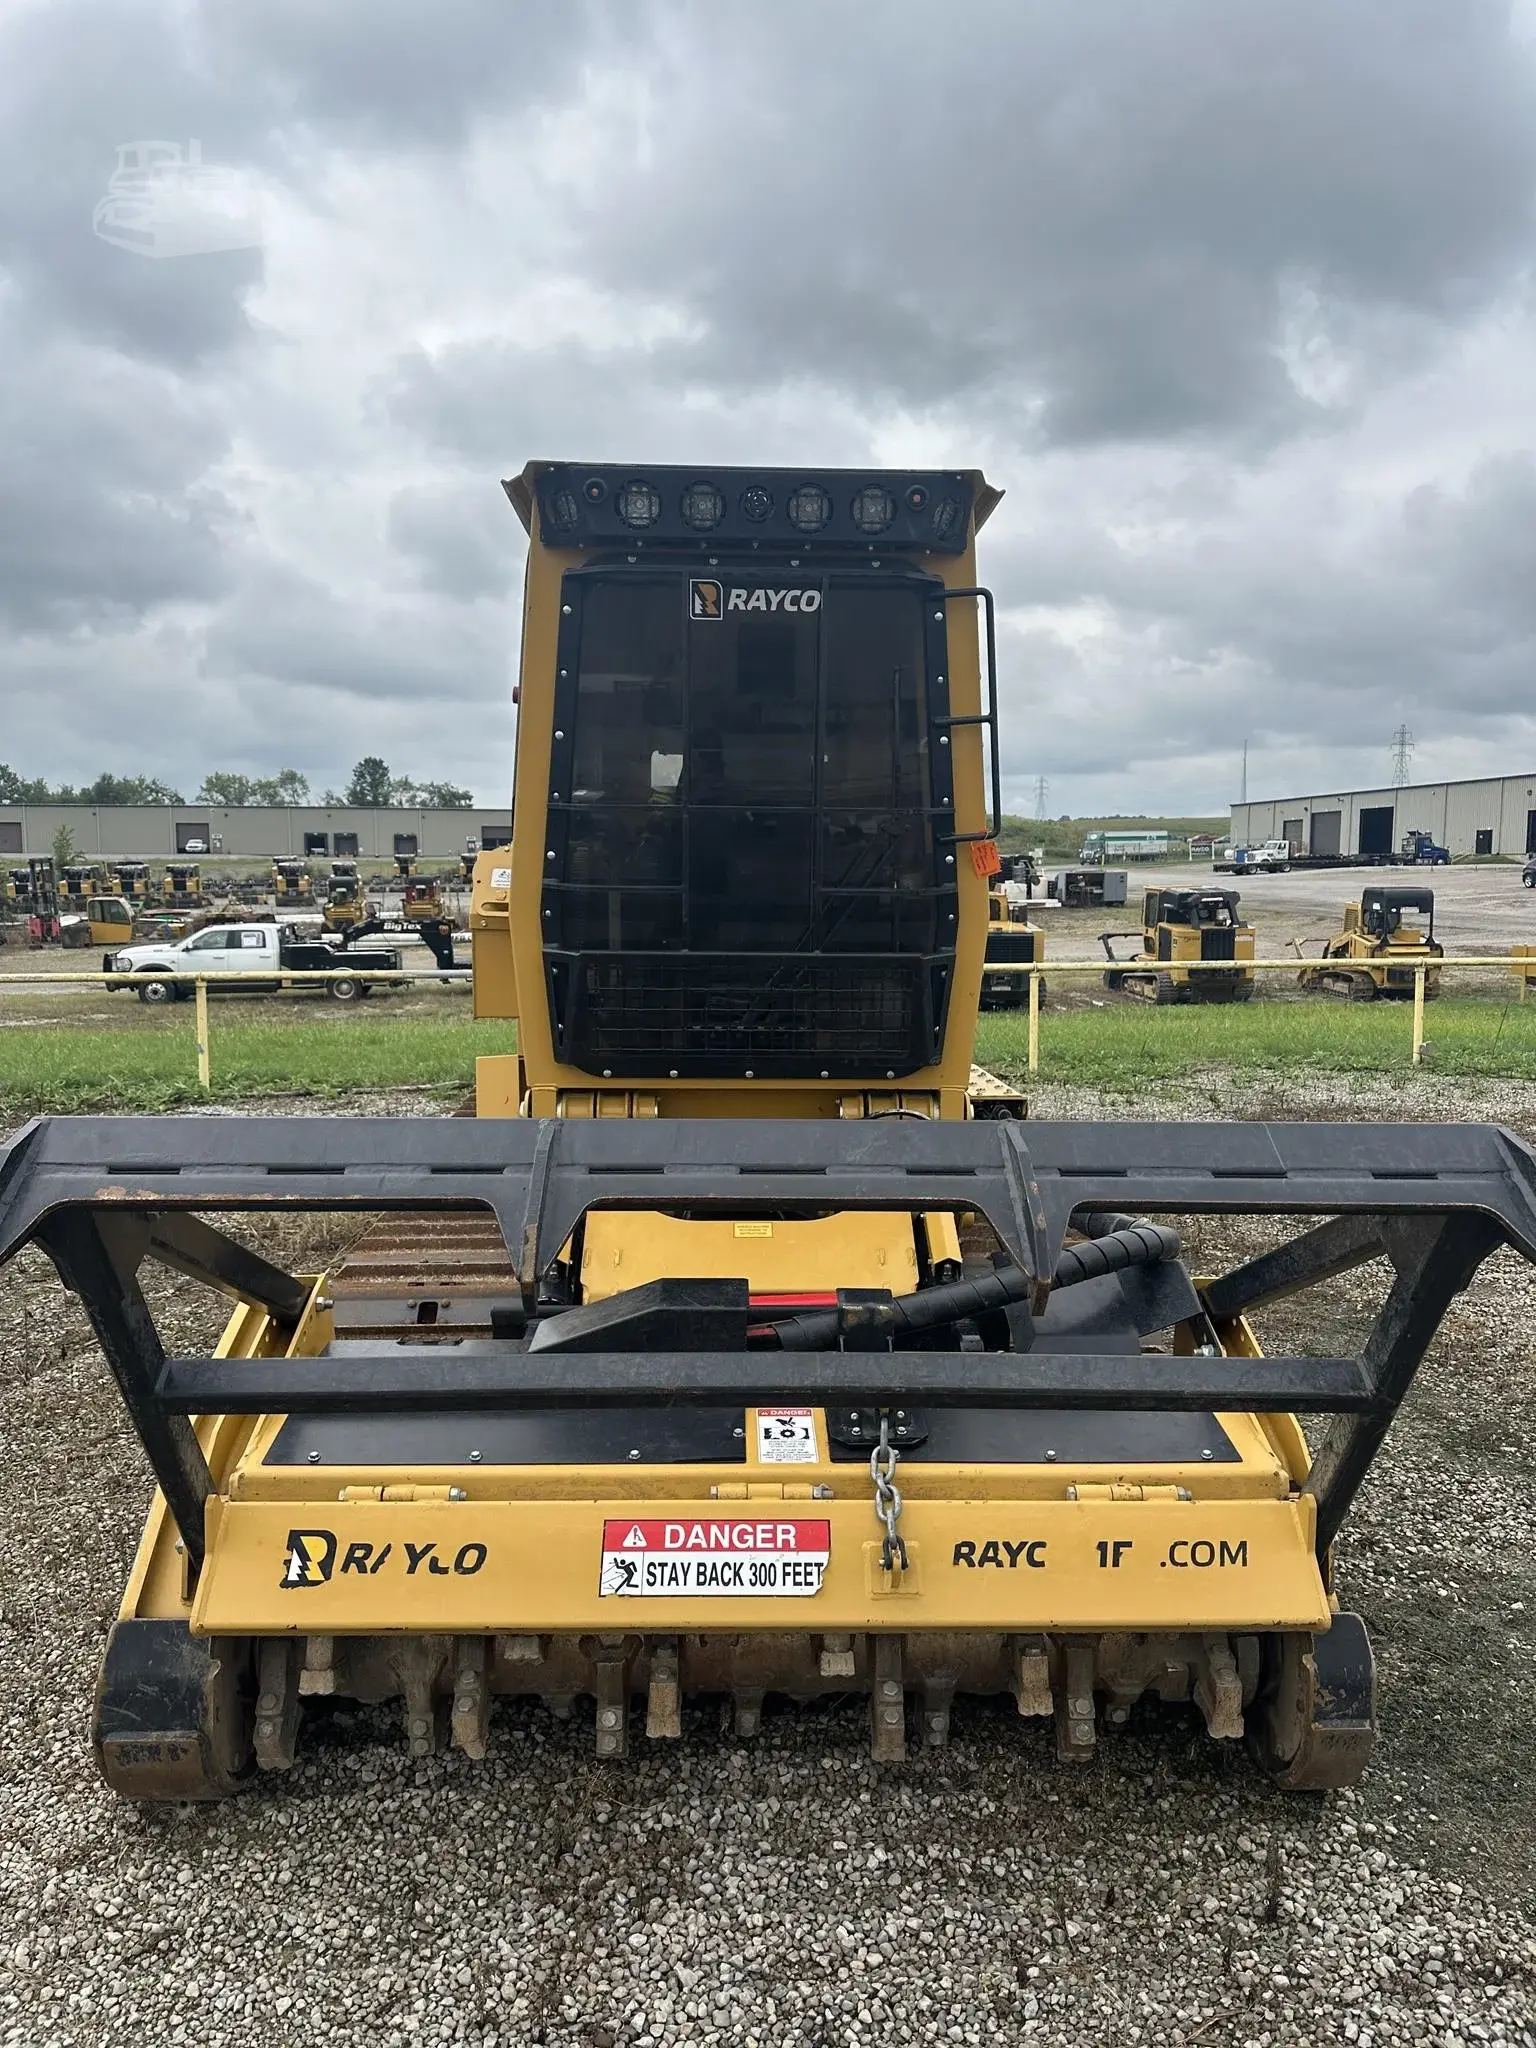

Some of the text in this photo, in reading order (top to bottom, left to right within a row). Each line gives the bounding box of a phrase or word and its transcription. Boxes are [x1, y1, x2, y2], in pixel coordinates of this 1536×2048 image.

[728, 588, 821, 612] RAYCO
[664, 1524, 797, 1549] DANGER
[646, 1562, 825, 1587] STAY BACK 300 FEET
